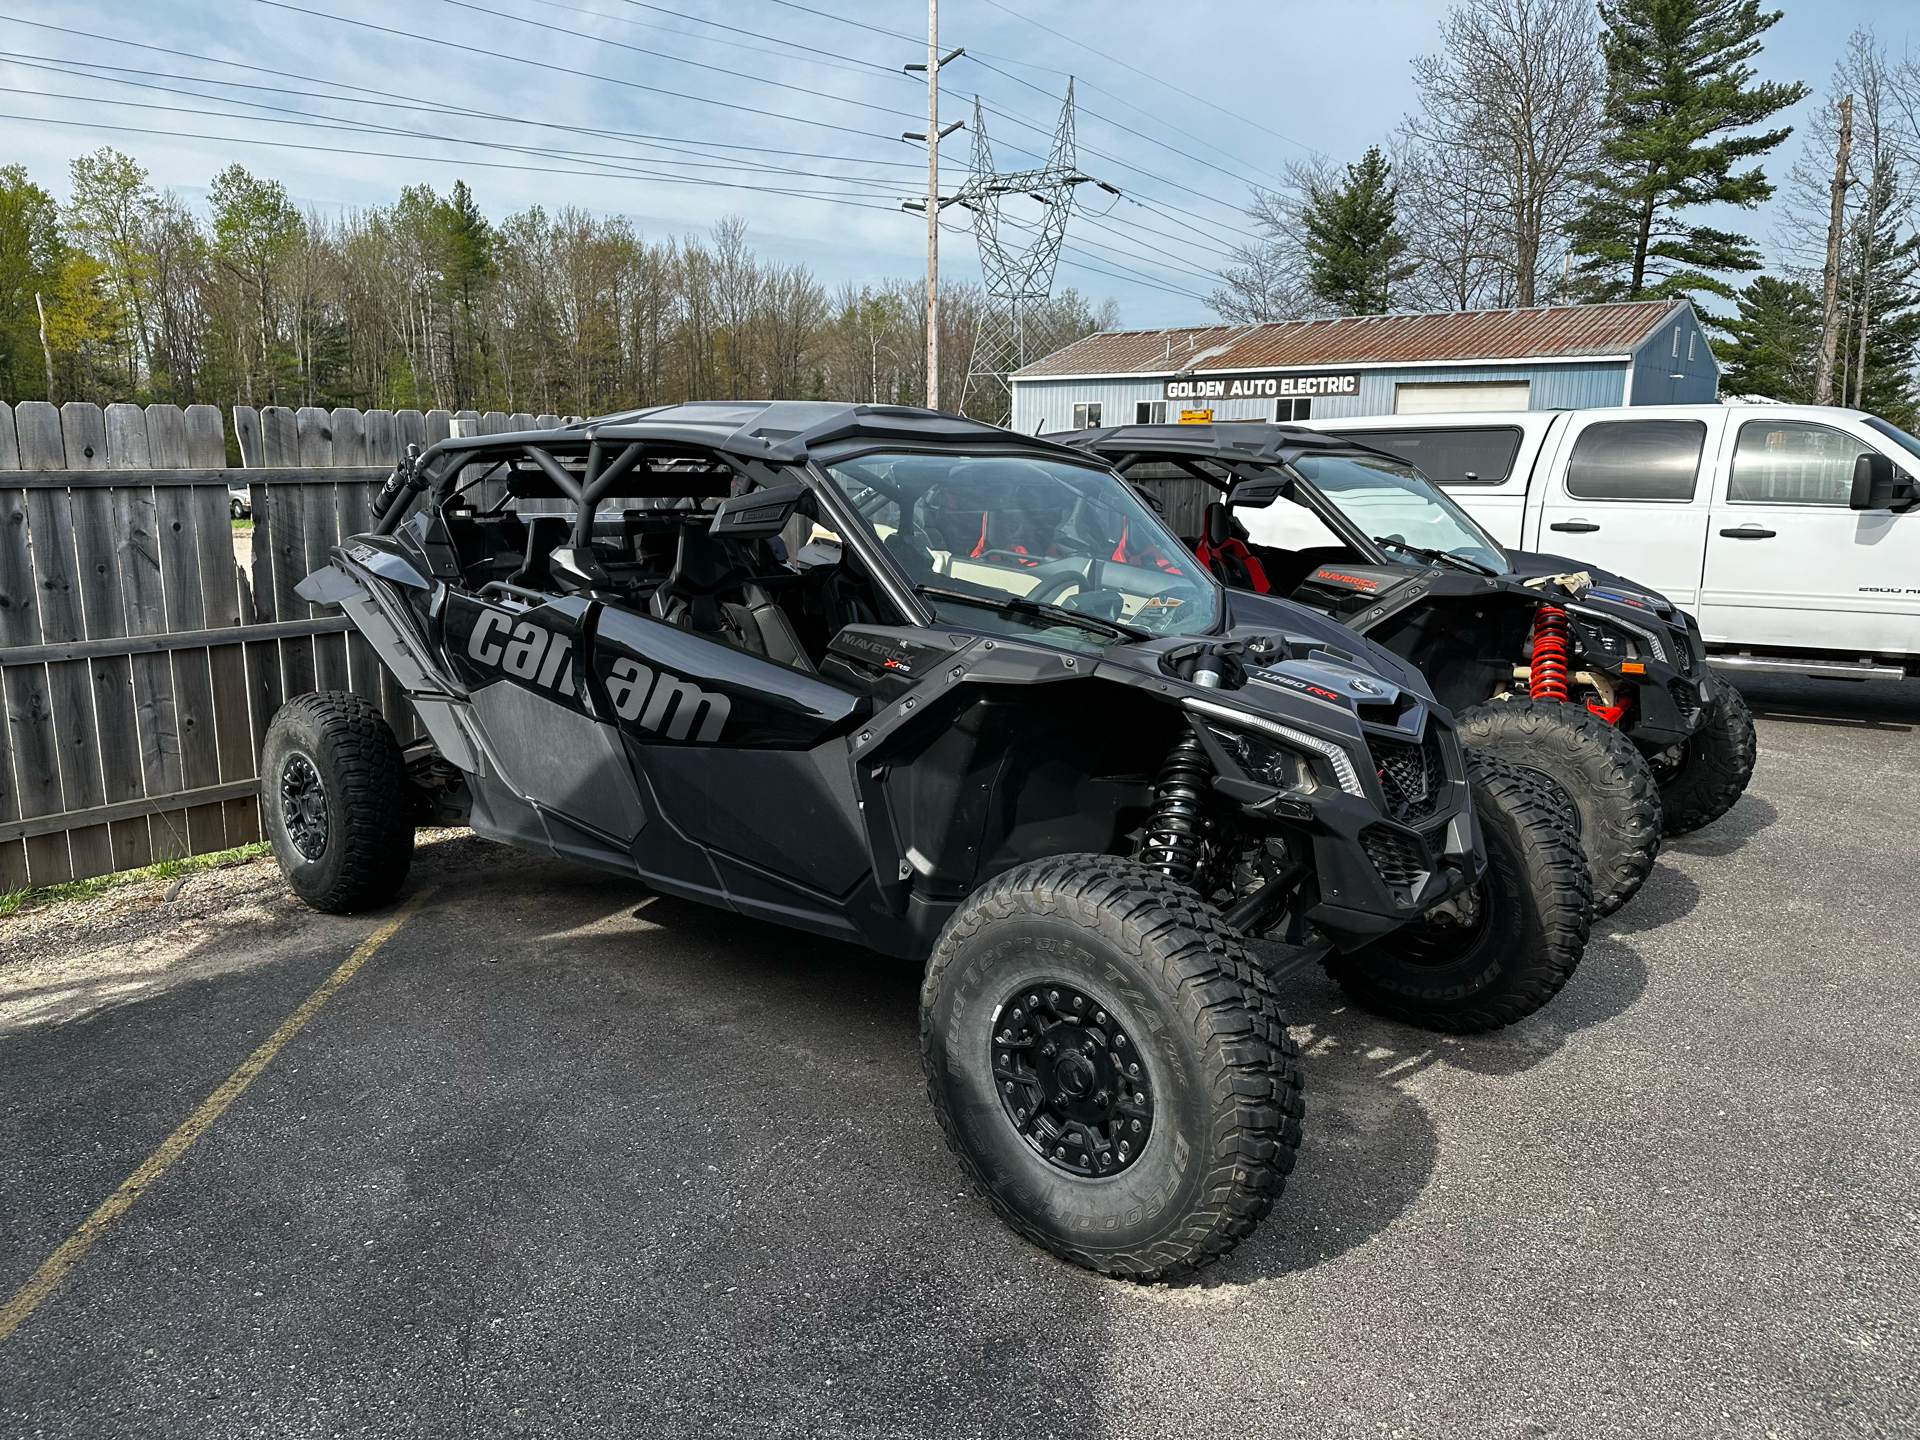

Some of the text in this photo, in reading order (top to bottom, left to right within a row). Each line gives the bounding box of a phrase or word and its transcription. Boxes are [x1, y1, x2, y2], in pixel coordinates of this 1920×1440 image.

[1167, 376, 1355, 398] GOLDEN AUTO ELECTRIC
[1317, 570, 1379, 589] MAVERICK
[841, 633, 916, 665] MAVERICK
[1255, 670, 1338, 700] TURBO RR
[993, 1131, 1191, 1233] BFGoodrich
